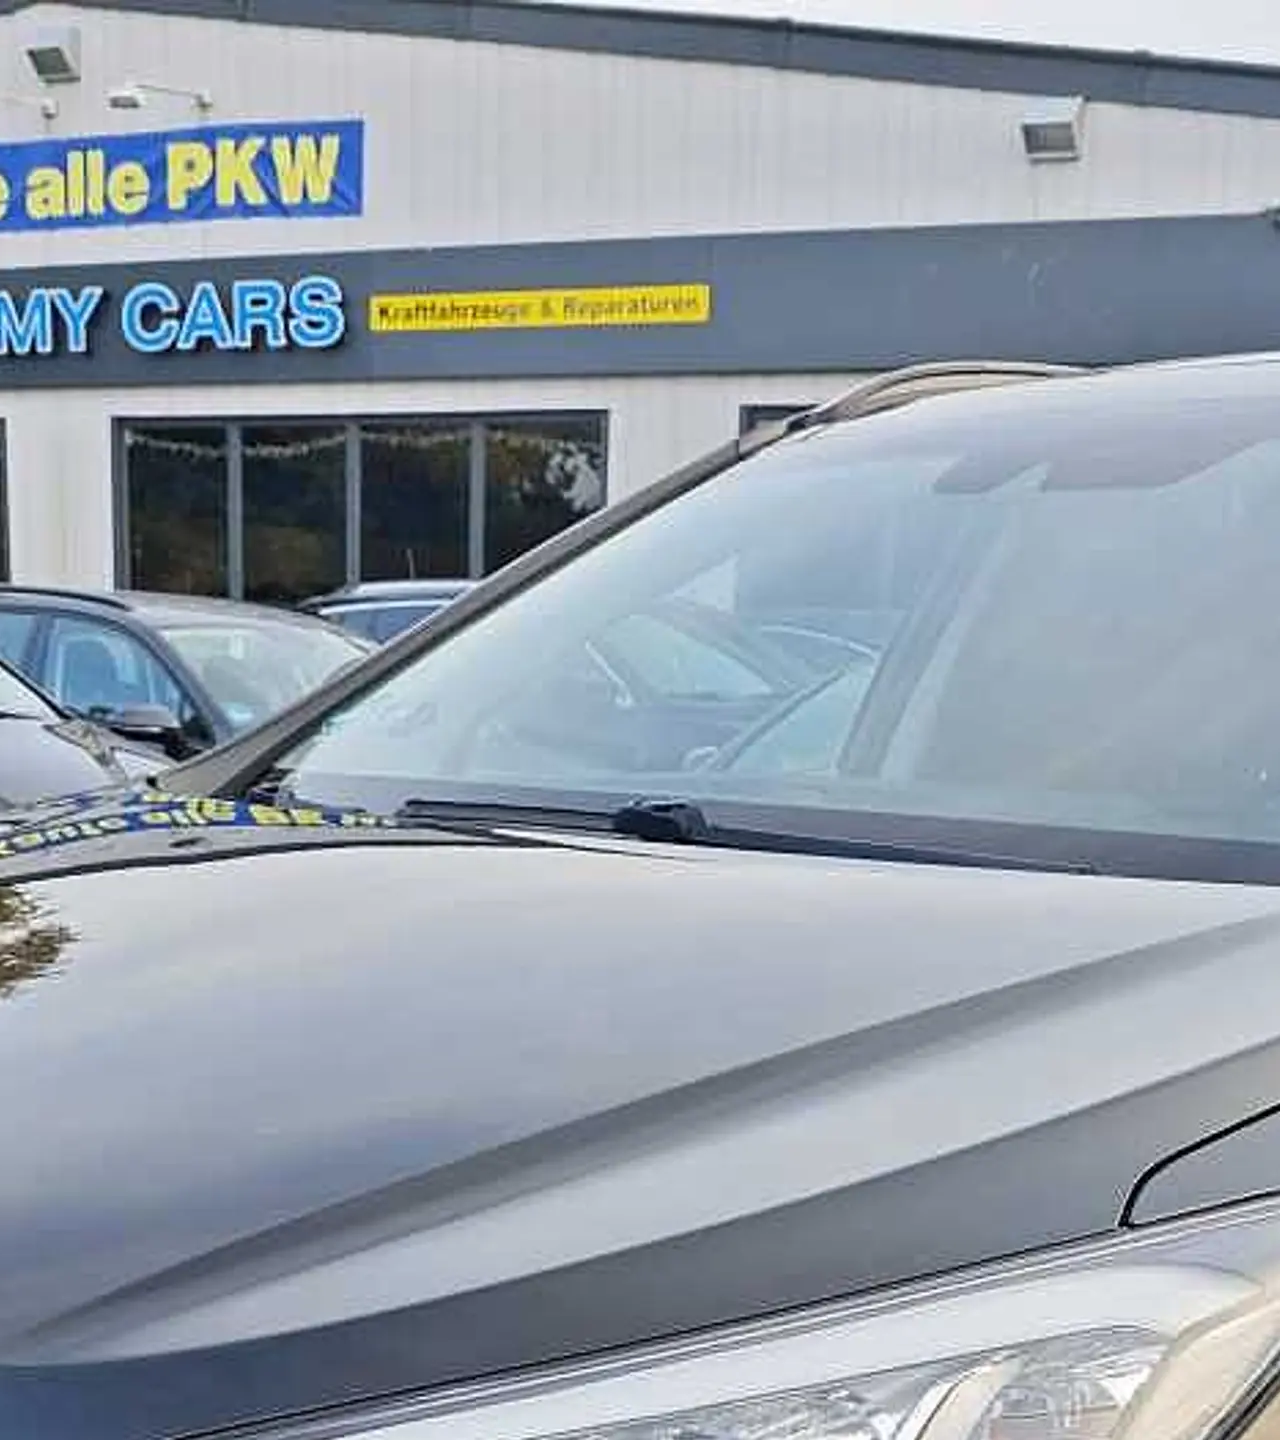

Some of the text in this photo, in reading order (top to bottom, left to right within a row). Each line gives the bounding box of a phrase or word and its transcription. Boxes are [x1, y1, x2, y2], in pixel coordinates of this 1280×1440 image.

[24, 149, 149, 220] alle
[166, 131, 341, 211] PKW
[120, 275, 346, 353] CARS
